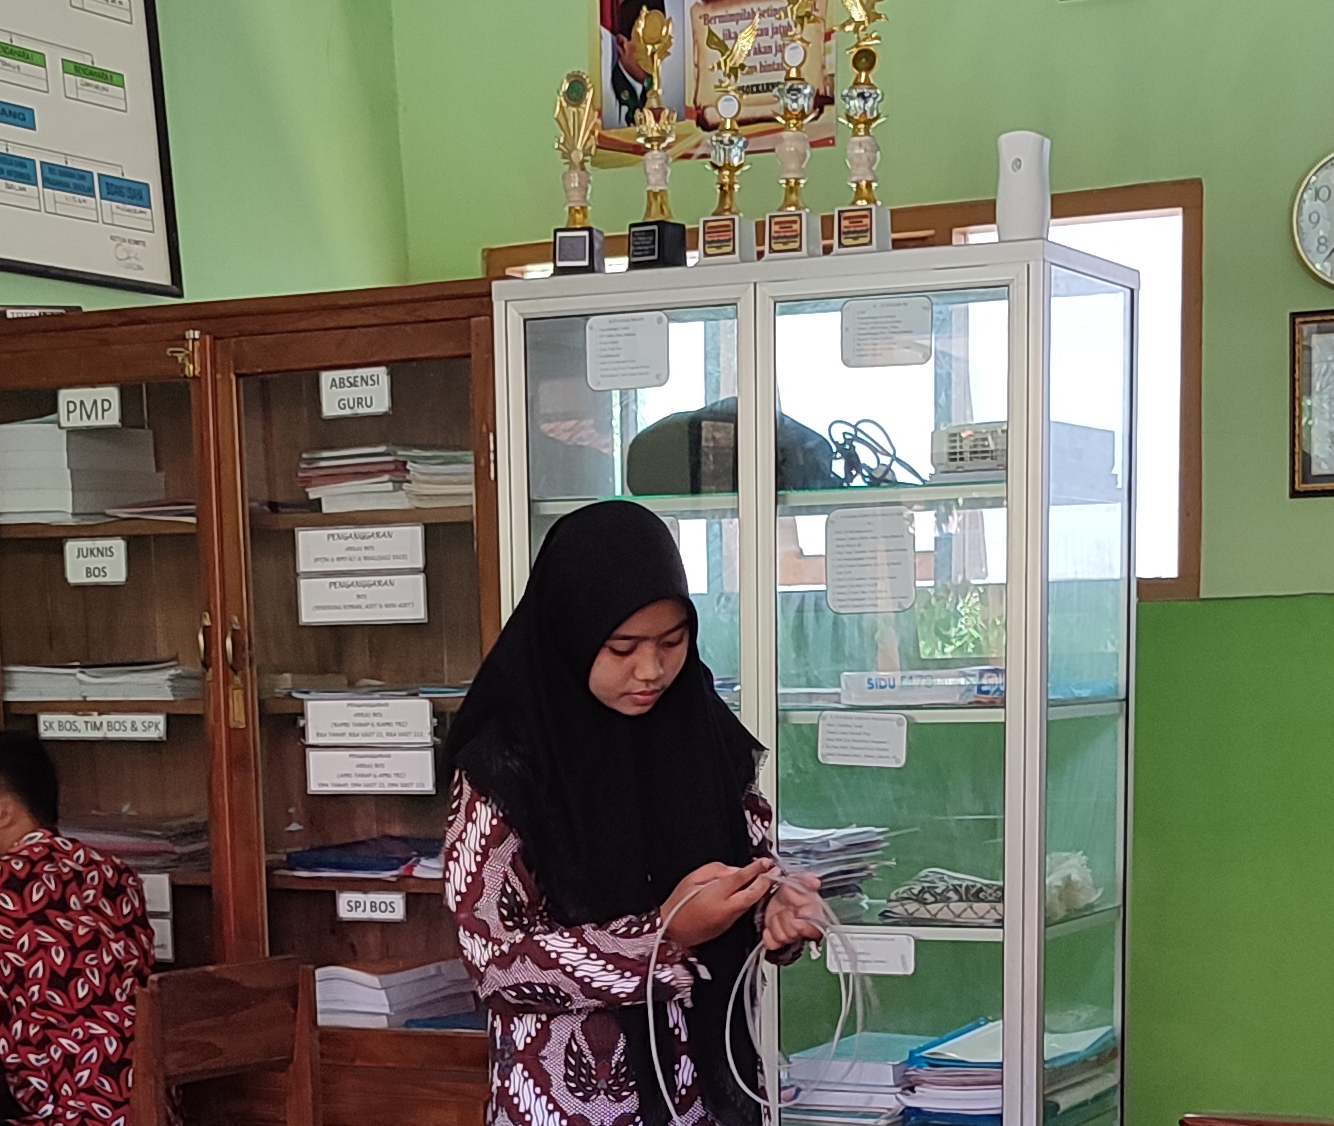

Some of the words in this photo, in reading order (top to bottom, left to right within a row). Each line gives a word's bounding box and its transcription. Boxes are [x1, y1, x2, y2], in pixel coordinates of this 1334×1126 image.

[1314, 185, 1331, 203] 10
[1308, 211, 1320, 229] 9
[1316, 235, 1328, 254] 8
[329, 374, 380, 390] ABSENSI
[66, 399, 112, 422] PMP
[337, 396, 373, 410] GURU
[76, 545, 114, 559] JUKNIS
[85, 566, 107, 579] BOS
[867, 677, 896, 690] SIDU
[43, 720, 55, 732] SK
[57, 720, 81, 733] BOS,
[84, 720, 104, 732] TIM
[107, 720, 128, 732] BOS
[130, 720, 138, 732] &
[141, 720, 162, 732] SPK
[346, 899, 367, 913] SPJ
[369, 900, 396, 914] BOS
